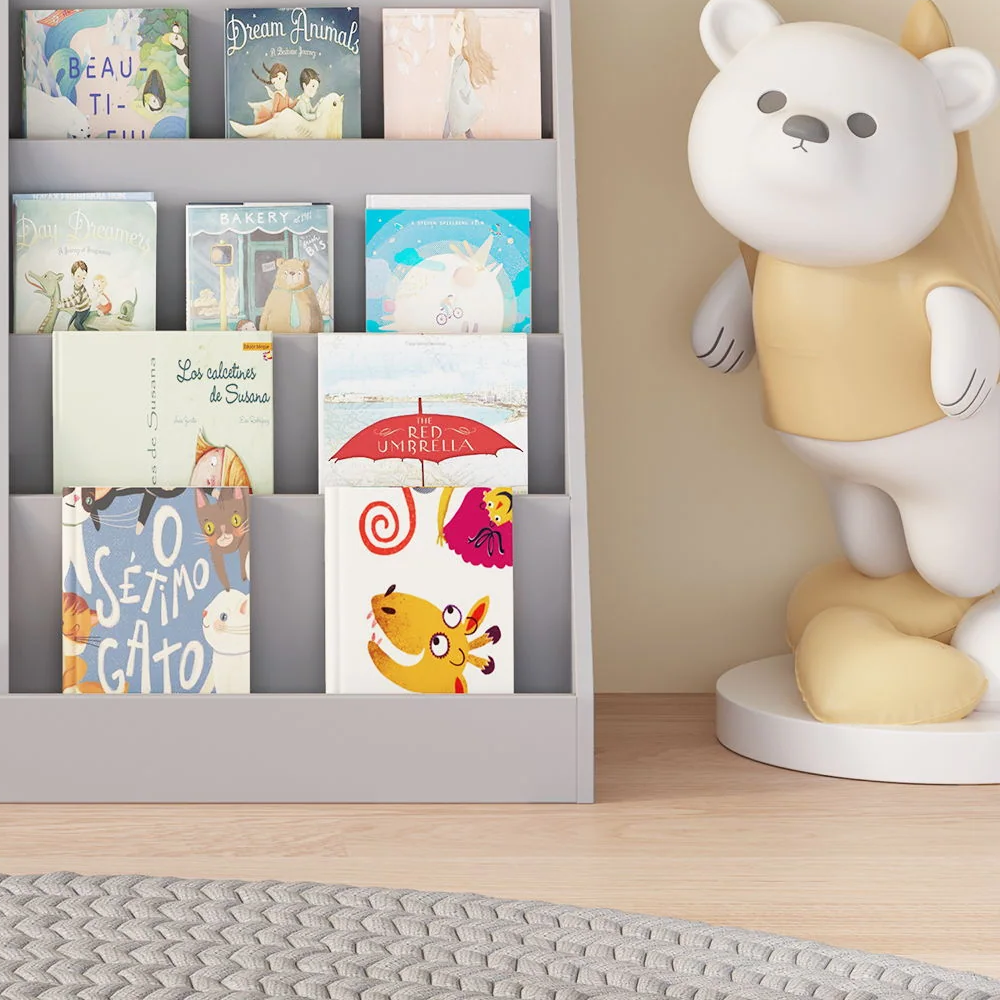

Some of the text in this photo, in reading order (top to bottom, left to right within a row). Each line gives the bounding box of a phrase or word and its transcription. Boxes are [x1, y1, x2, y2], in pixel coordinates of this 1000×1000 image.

[226, 7, 361, 57] Dream Animals
[68, 56, 148, 79] BEAU-
[220, 211, 289, 225] BAKERY
[16, 207, 151, 254] Day Dreamers
[176, 358, 257, 384] Los calcetines
[146, 357, 159, 431] Susana
[209, 383, 271, 405] de Susana
[407, 425, 443, 439] RED
[416, 416, 433, 425] THE
[147, 437, 158, 460] de
[377, 439, 475, 456] UMBRELLA
[152, 505, 184, 568] O
[97, 619, 205, 694] GATO
